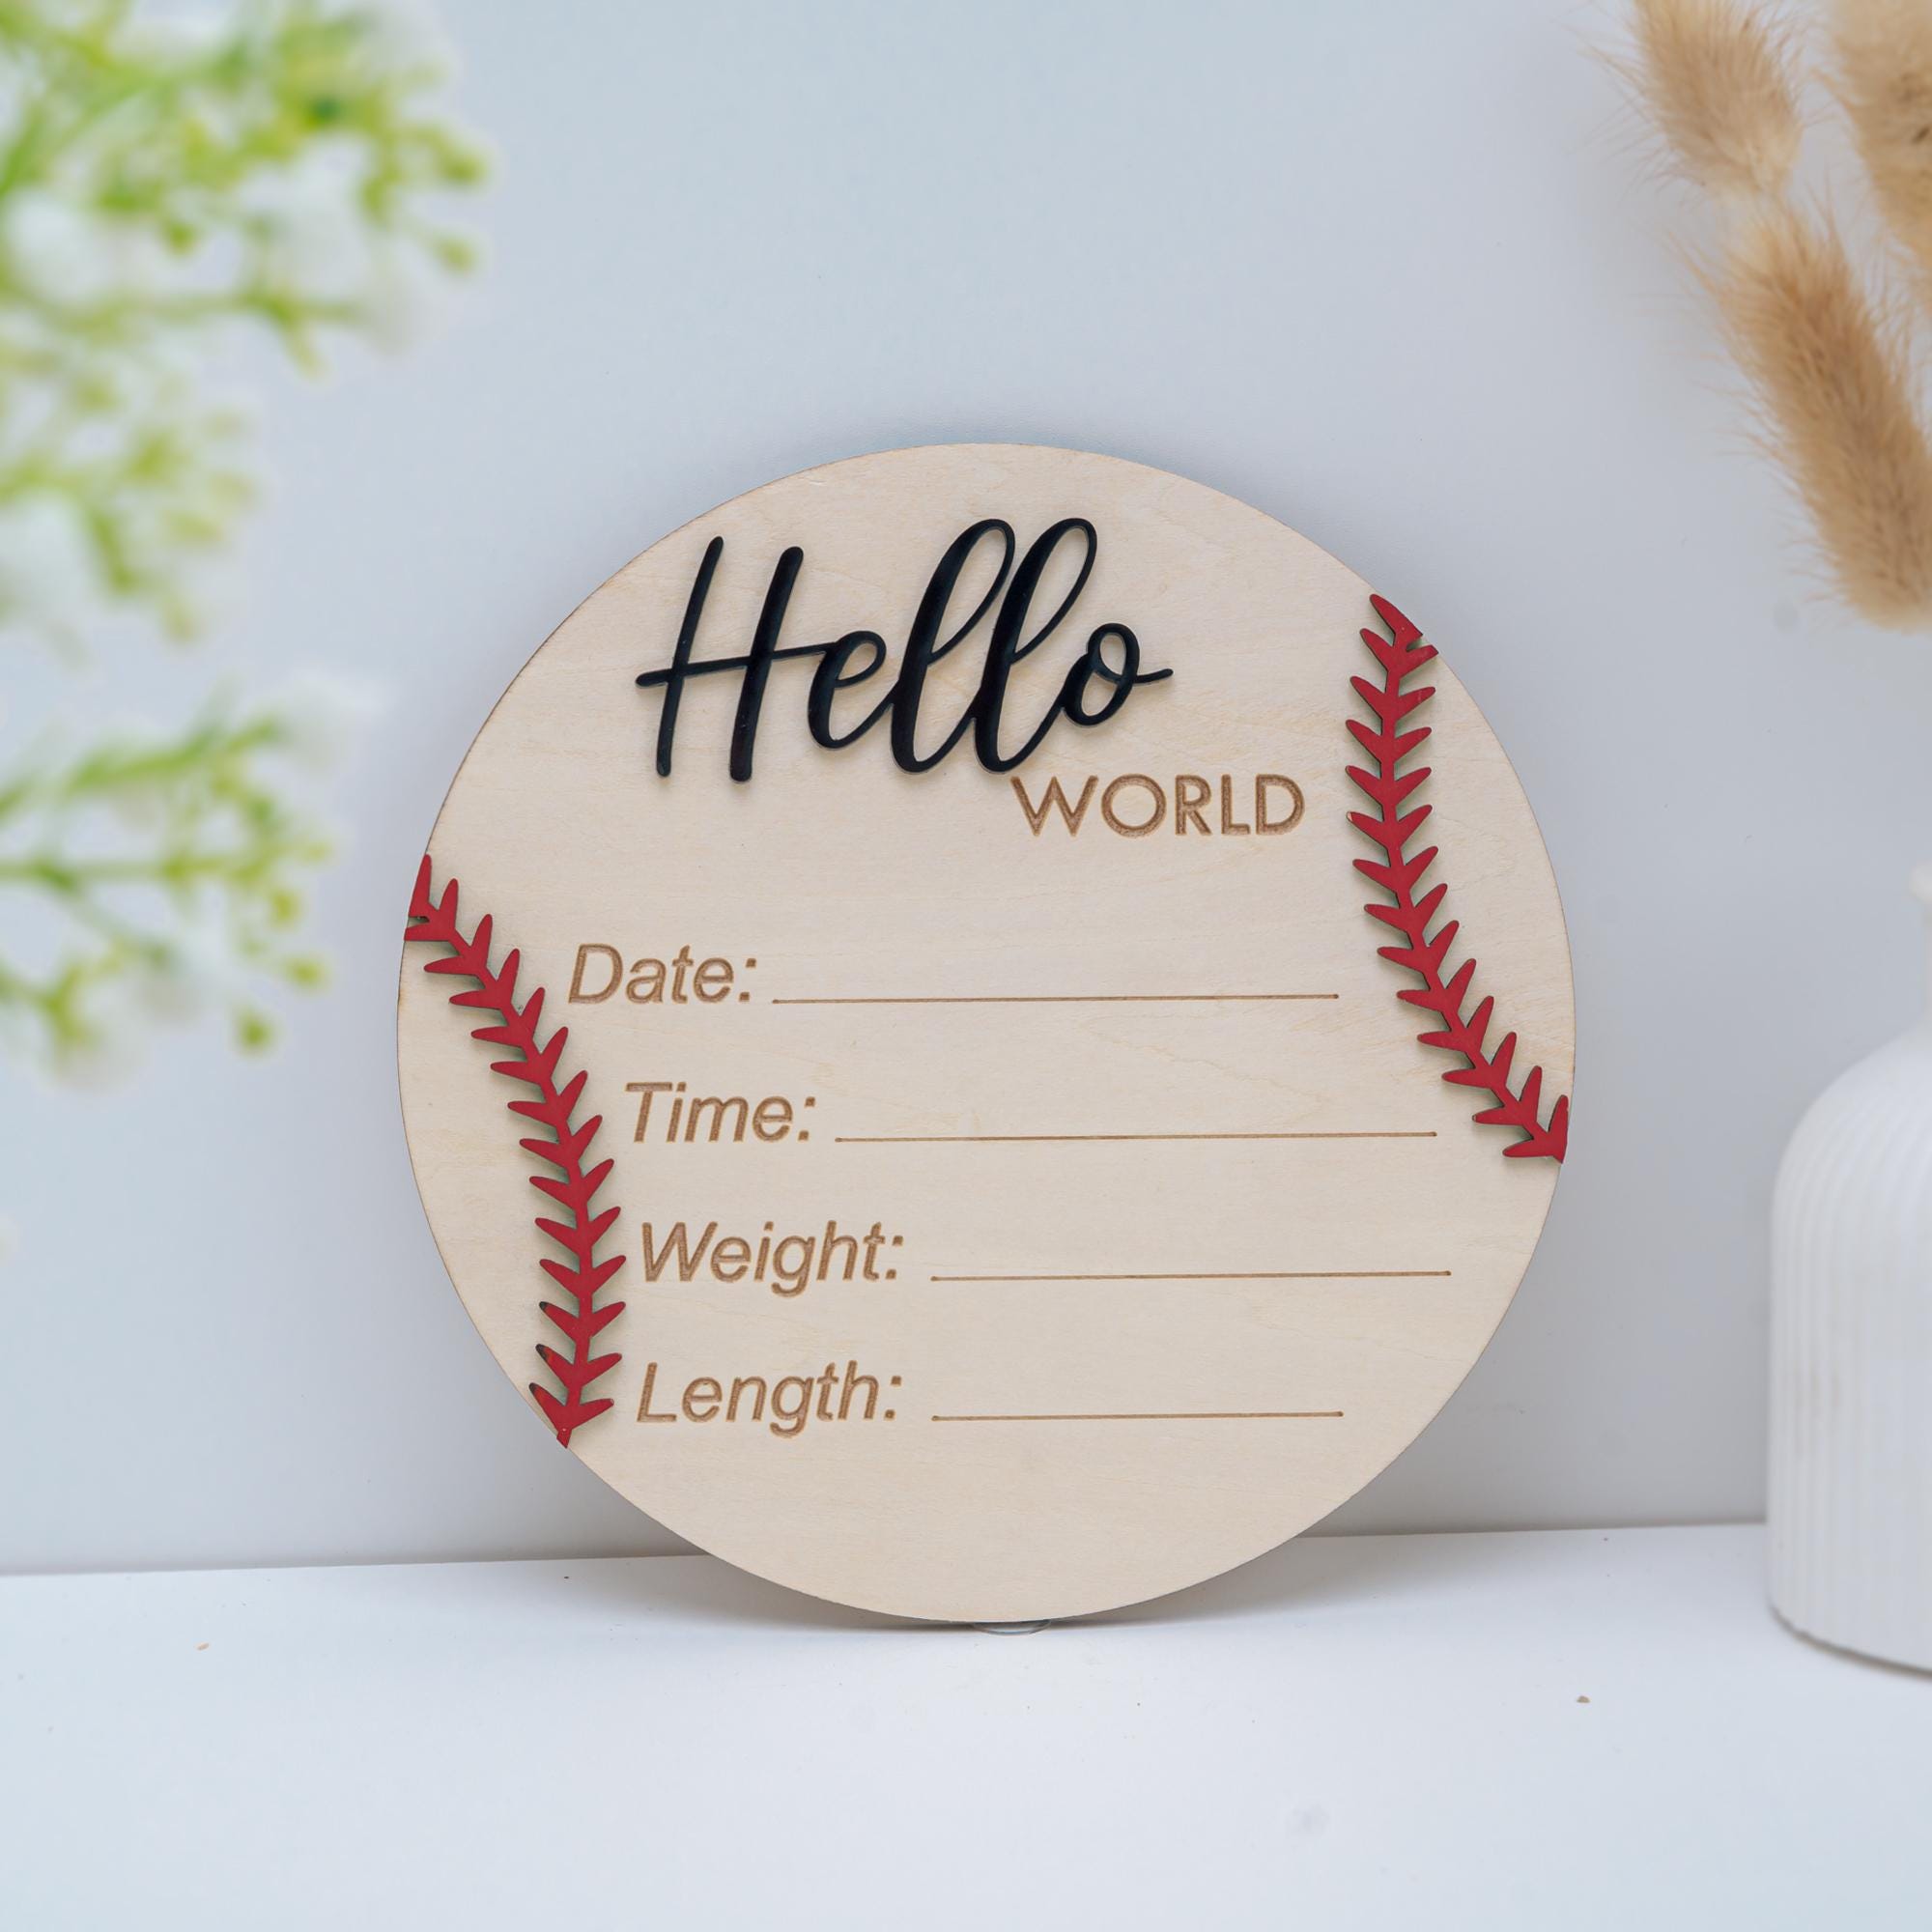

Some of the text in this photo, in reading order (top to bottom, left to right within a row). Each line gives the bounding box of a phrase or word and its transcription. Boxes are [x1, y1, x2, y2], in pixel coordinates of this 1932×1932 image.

[636, 517, 1174, 782] Hello
[1010, 774, 1306, 838] WORLD
[567, 943, 757, 1005] Date:
[624, 1081, 816, 1144] Time:
[640, 1220, 904, 1297] Weight:
[636, 1359, 902, 1438] Length:
